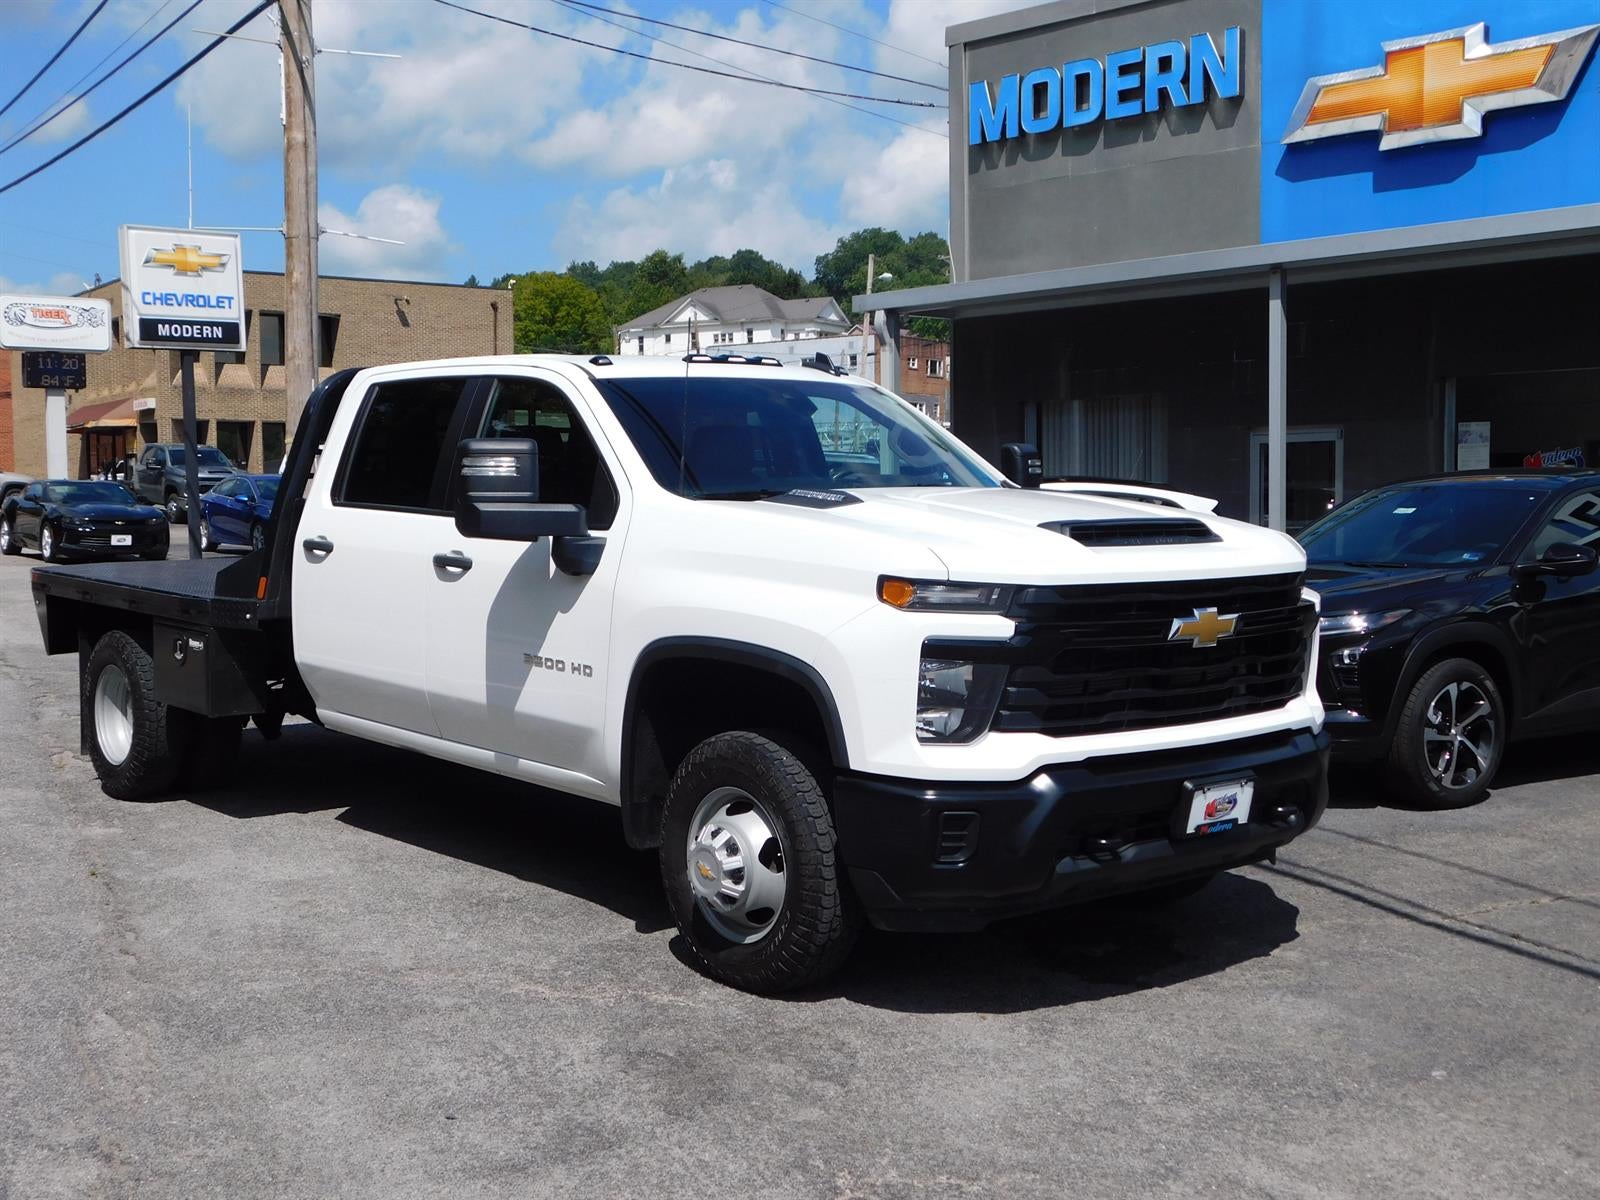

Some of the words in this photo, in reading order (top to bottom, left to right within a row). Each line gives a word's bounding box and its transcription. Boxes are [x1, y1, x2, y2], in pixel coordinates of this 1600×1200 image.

[969, 25, 1240, 146] MODERN
[141, 291, 234, 309] CHEVROLET
[157, 323, 223, 338] MODERN
[38, 358, 79, 370] 11:20
[571, 661, 593, 678] HD
